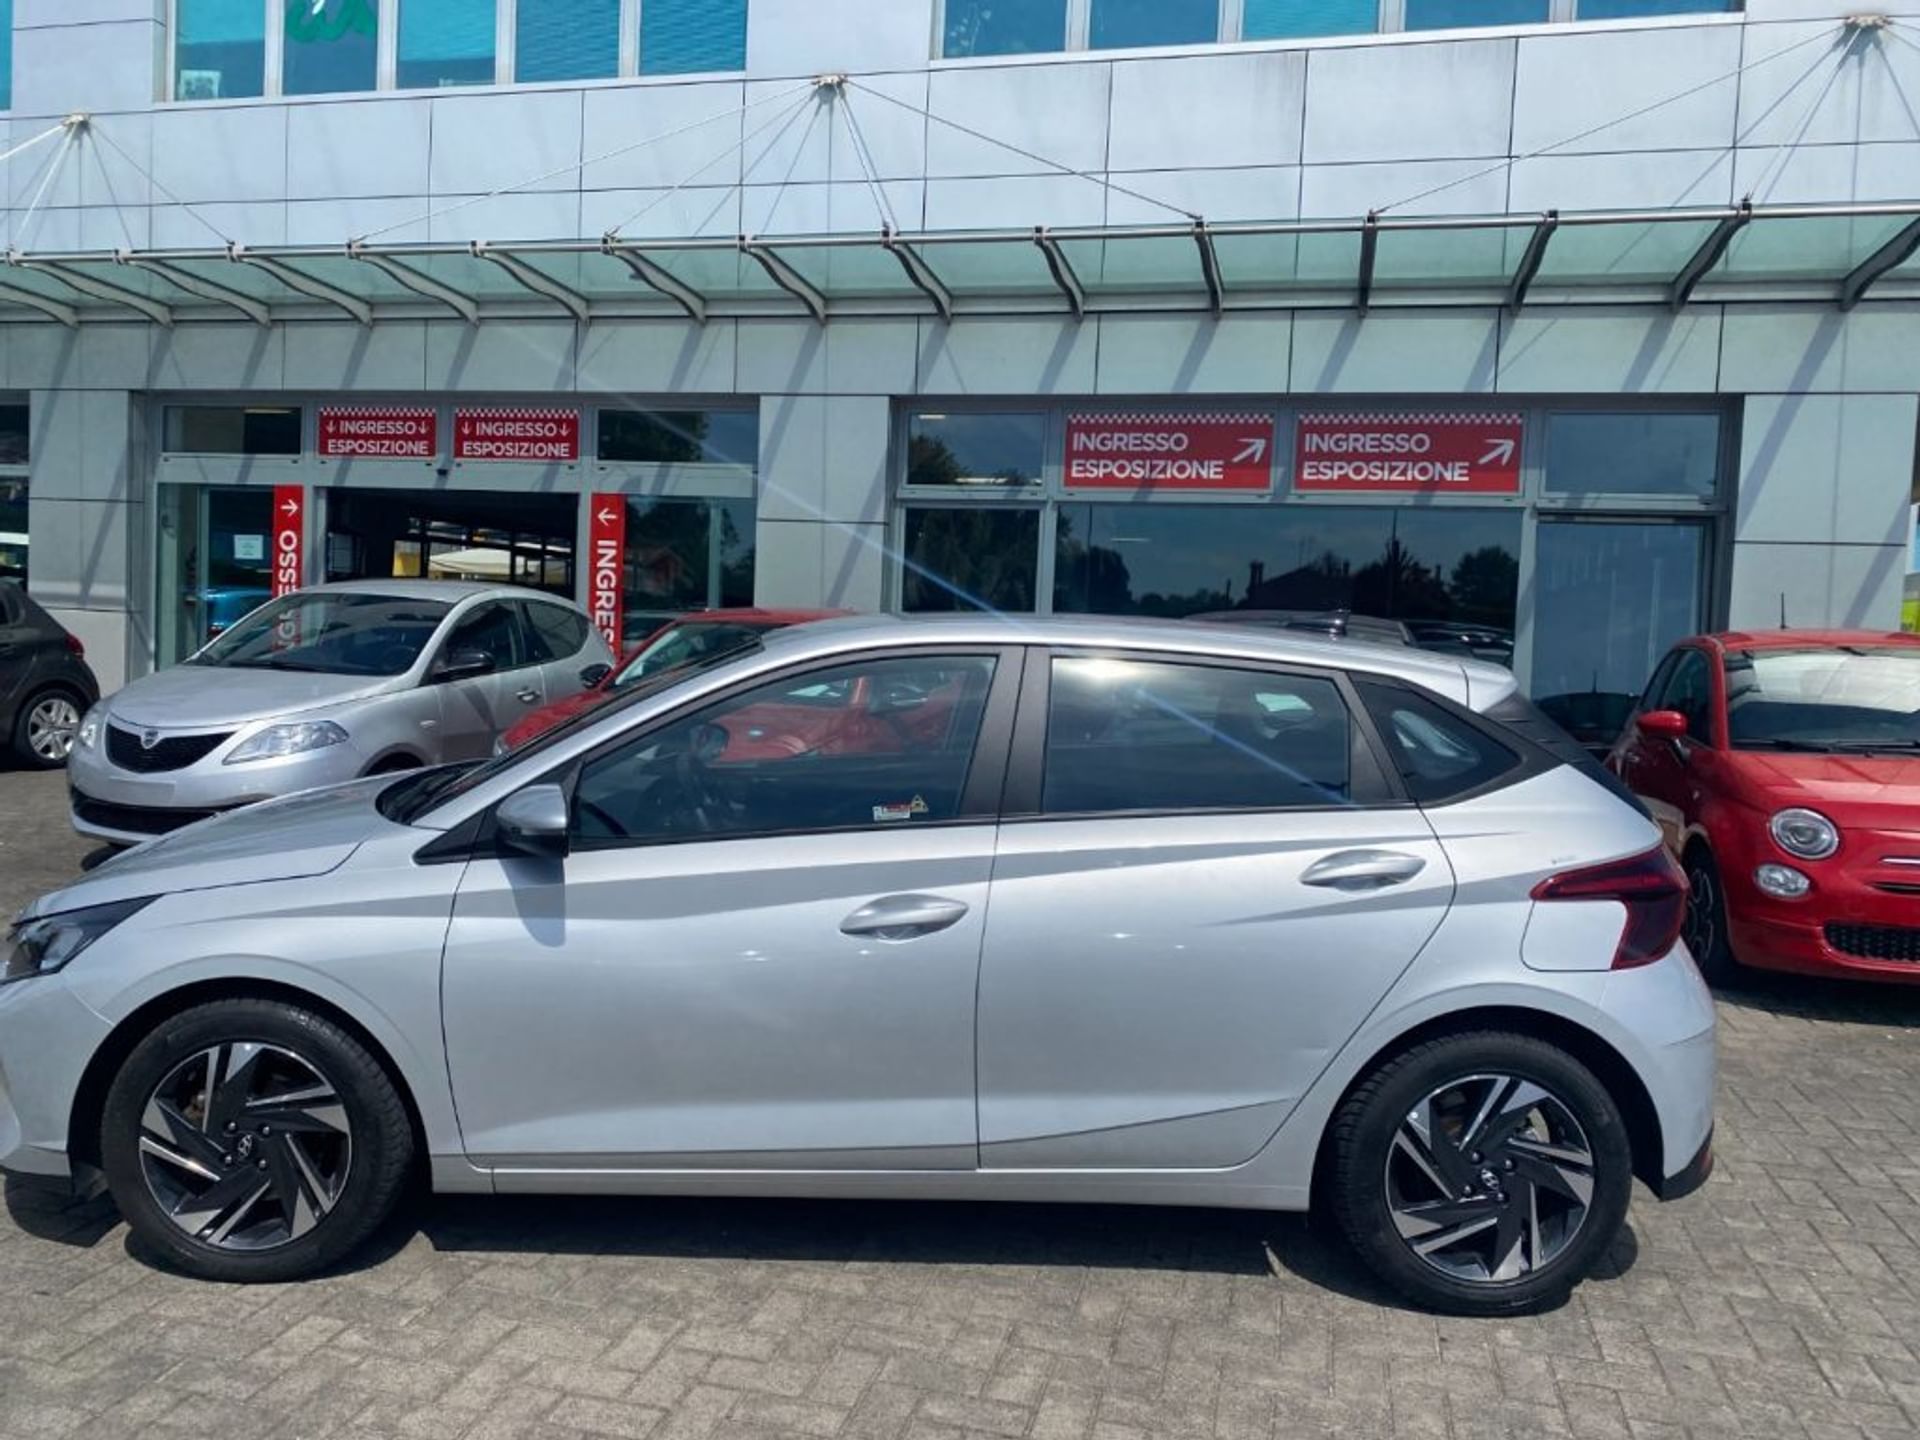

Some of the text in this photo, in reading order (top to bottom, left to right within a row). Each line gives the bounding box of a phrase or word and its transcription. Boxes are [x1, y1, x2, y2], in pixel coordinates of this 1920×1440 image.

[340, 420, 417, 435] INGRESSO
[476, 421, 557, 437] INGRESSO
[328, 439, 429, 455] ESPOSIZIONE
[463, 441, 570, 457] ESPOSIZIONE
[1072, 432, 1189, 452] INGRESSO
[1304, 433, 1430, 453] INGRESSO
[1071, 459, 1224, 480] ESPOSIZIONE
[1303, 461, 1470, 481] ESPOSIZIONE
